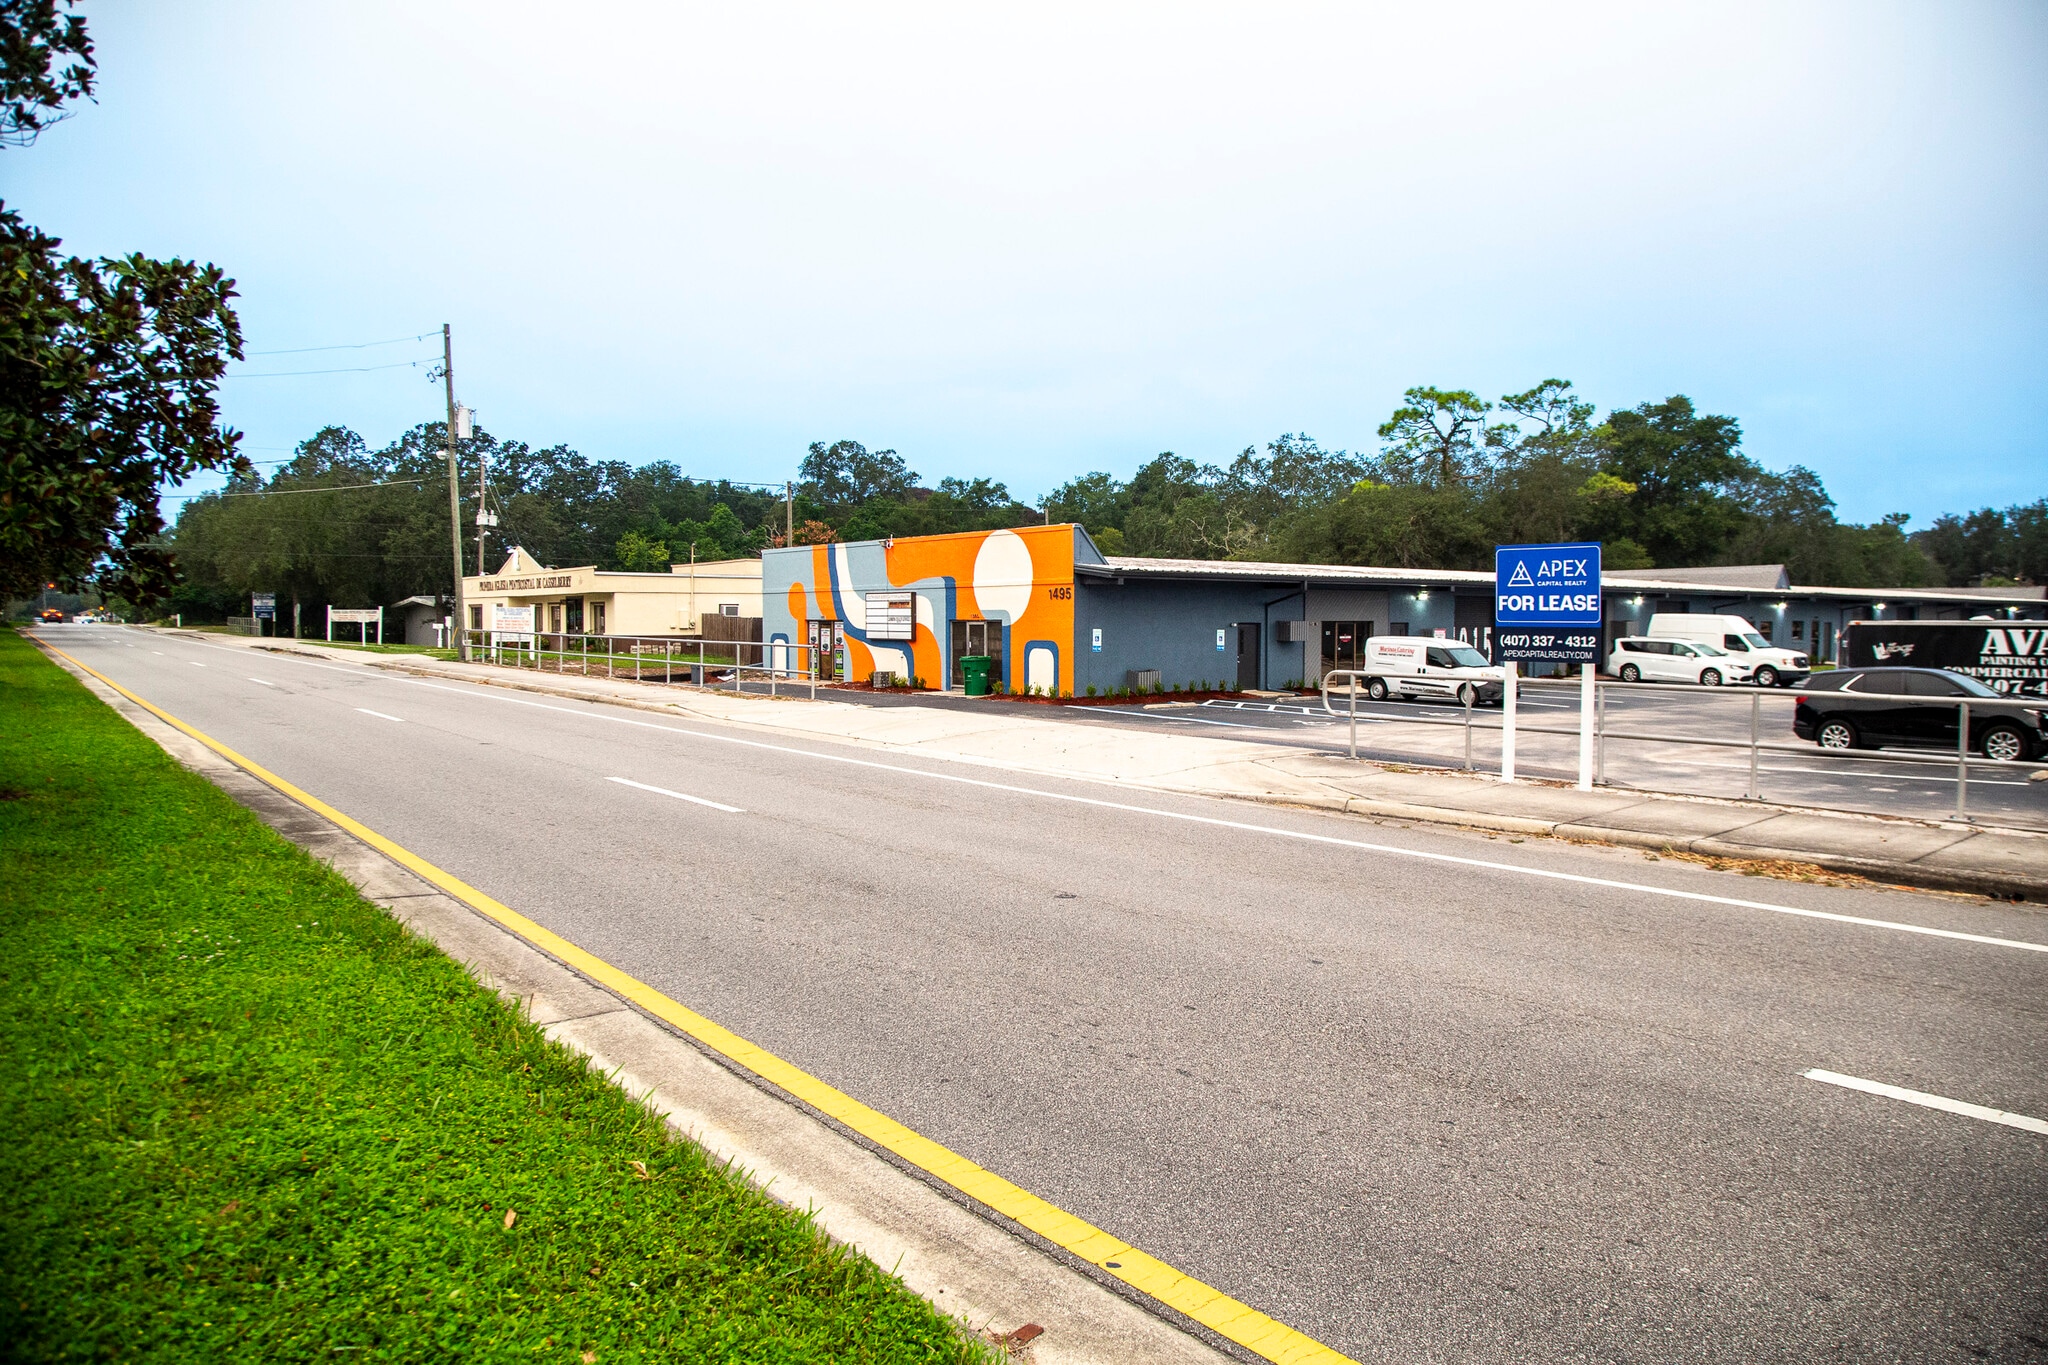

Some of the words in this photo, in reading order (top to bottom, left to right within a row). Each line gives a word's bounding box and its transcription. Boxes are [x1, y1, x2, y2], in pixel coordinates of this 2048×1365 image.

[1537, 559, 1587, 577] APEX
[1048, 587, 1072, 600] 1495
[1498, 595, 1535, 611] FOR
[1538, 595, 1598, 611] LEASE
[1500, 634, 1530, 647] (407)
[1532, 636, 1555, 647] 337
[1565, 636, 1596, 647] 4312
[1503, 650, 1592, 659] APEXCAPITALREALTY.COM
[1980, 656, 2036, 666] PAINTING
